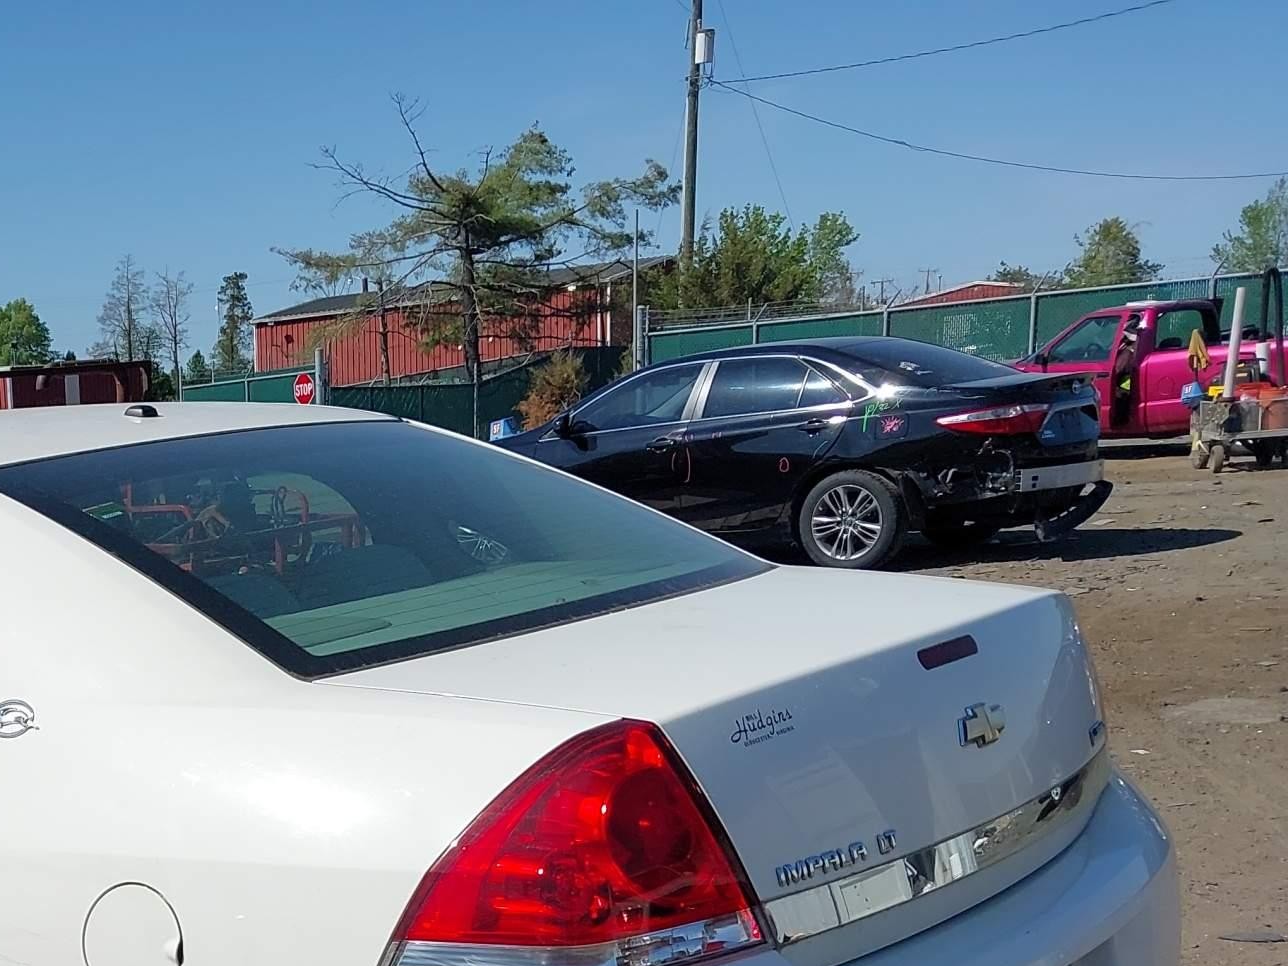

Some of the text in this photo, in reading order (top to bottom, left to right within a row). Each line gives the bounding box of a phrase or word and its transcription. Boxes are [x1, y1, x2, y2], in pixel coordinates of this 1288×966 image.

[295, 382, 312, 397] STOP
[731, 709, 792, 743] Hudgins
[775, 830, 896, 887] IMPALA LT
